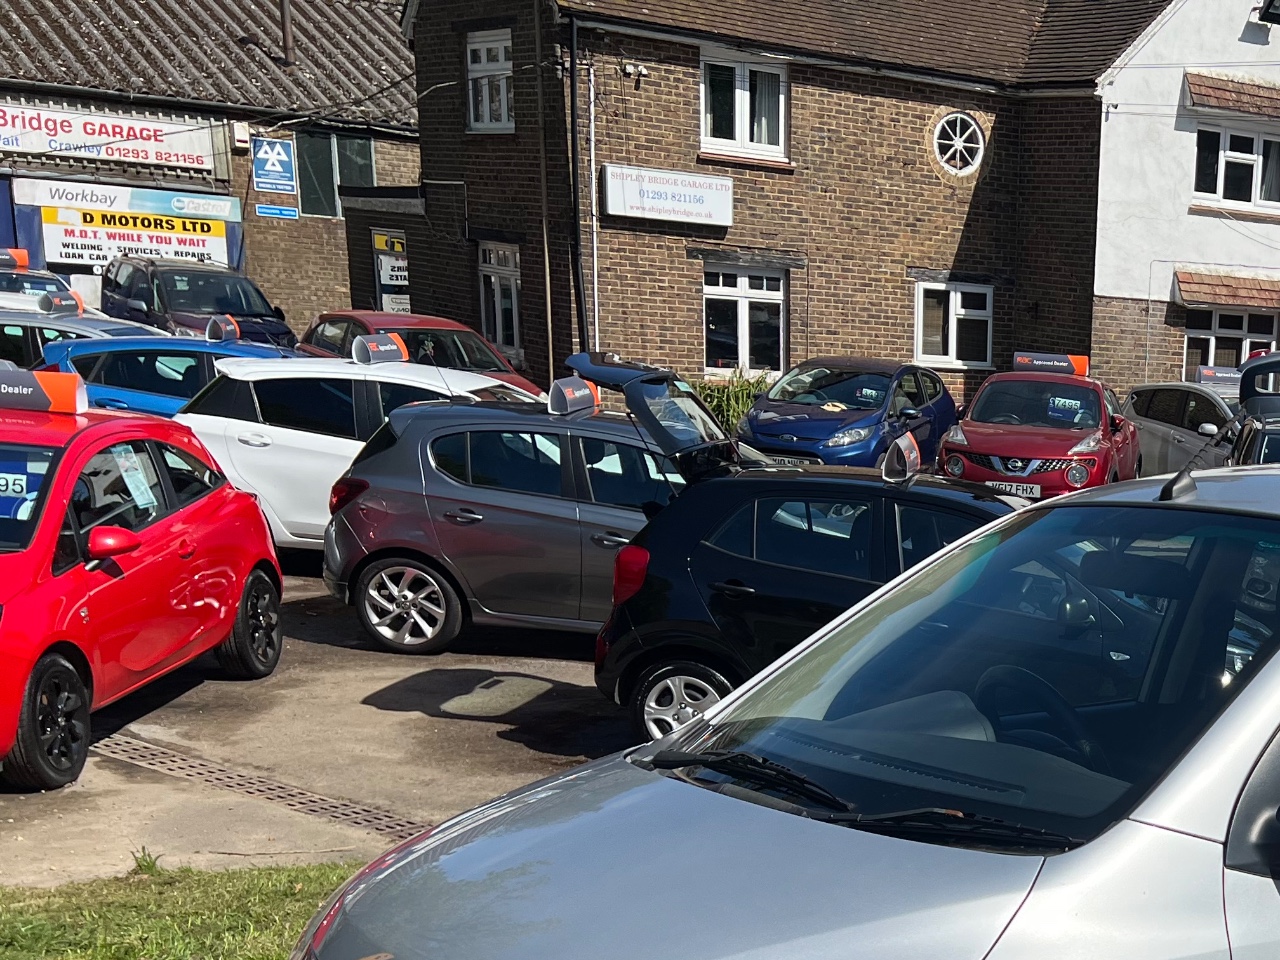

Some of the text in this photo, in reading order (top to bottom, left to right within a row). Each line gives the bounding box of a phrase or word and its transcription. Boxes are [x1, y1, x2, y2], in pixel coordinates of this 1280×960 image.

[83, 121, 164, 142] GARAGE
[0, 134, 19, 147] ait
[49, 138, 204, 165] Crawley 01293 821156
[610, 171, 730, 192] SHIPLEY BRIDGE GARAGE LTD
[49, 187, 117, 208] Workbay
[639, 189, 704, 205] 01293 821156
[185, 200, 228, 214] Castrol
[629, 204, 713, 219] www.shipleybridge.co.uk
[82, 212, 212, 233] D MOTORS LTD
[64, 228, 207, 248] M.O.T. WHILE YOU WAIT
[60, 251, 108, 261] LOAN CAR
[61, 242, 212, 260] WELDING SERVICES REPAIRS
[1, 384, 33, 395] Dealer
[1015, 484, 1035, 495] FHX
